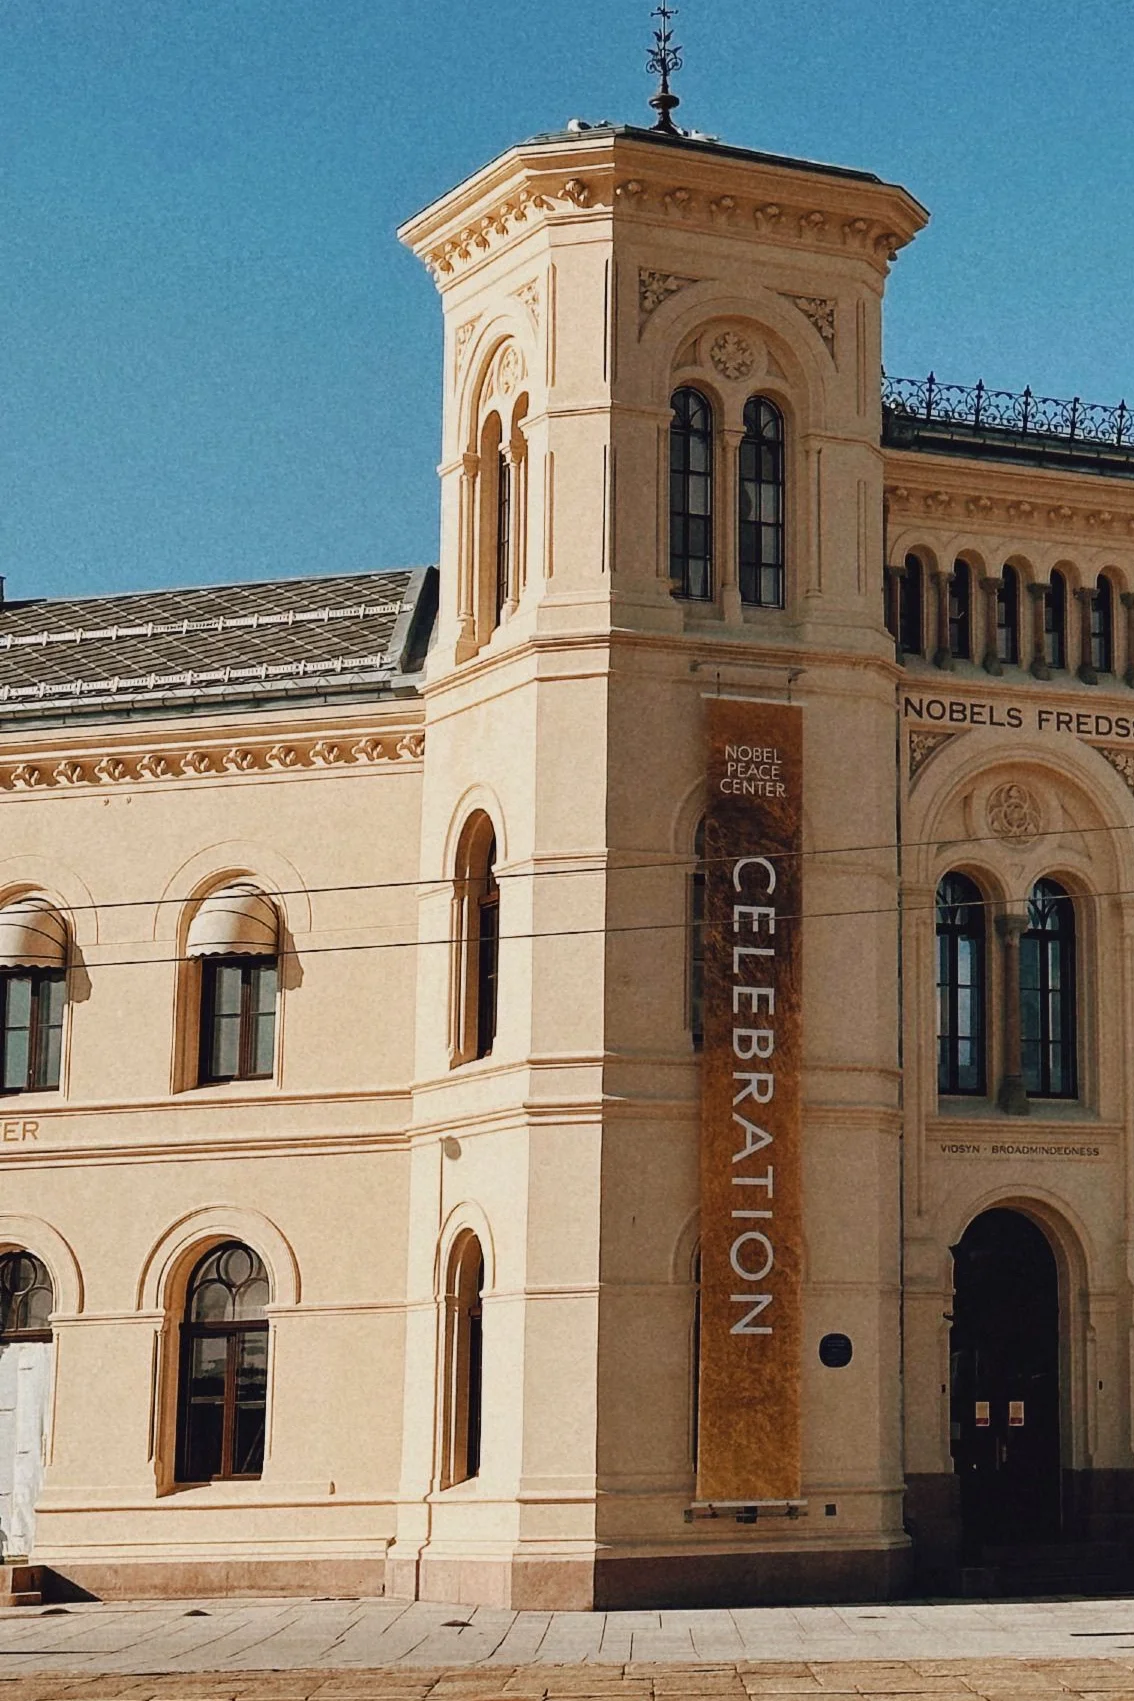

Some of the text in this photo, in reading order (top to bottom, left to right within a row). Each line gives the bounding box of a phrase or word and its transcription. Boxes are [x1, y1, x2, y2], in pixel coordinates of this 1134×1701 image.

[903, 697, 1023, 728] NOBELS
[725, 745, 782, 763] NOBEL
[727, 762, 780, 779] PEACE
[719, 778, 786, 797] CENTER
[730, 856, 777, 1335] CELEBRATION
[0, 1121, 40, 1142] ER
[991, 1145, 1100, 1157] BROADMINDEDNESS
